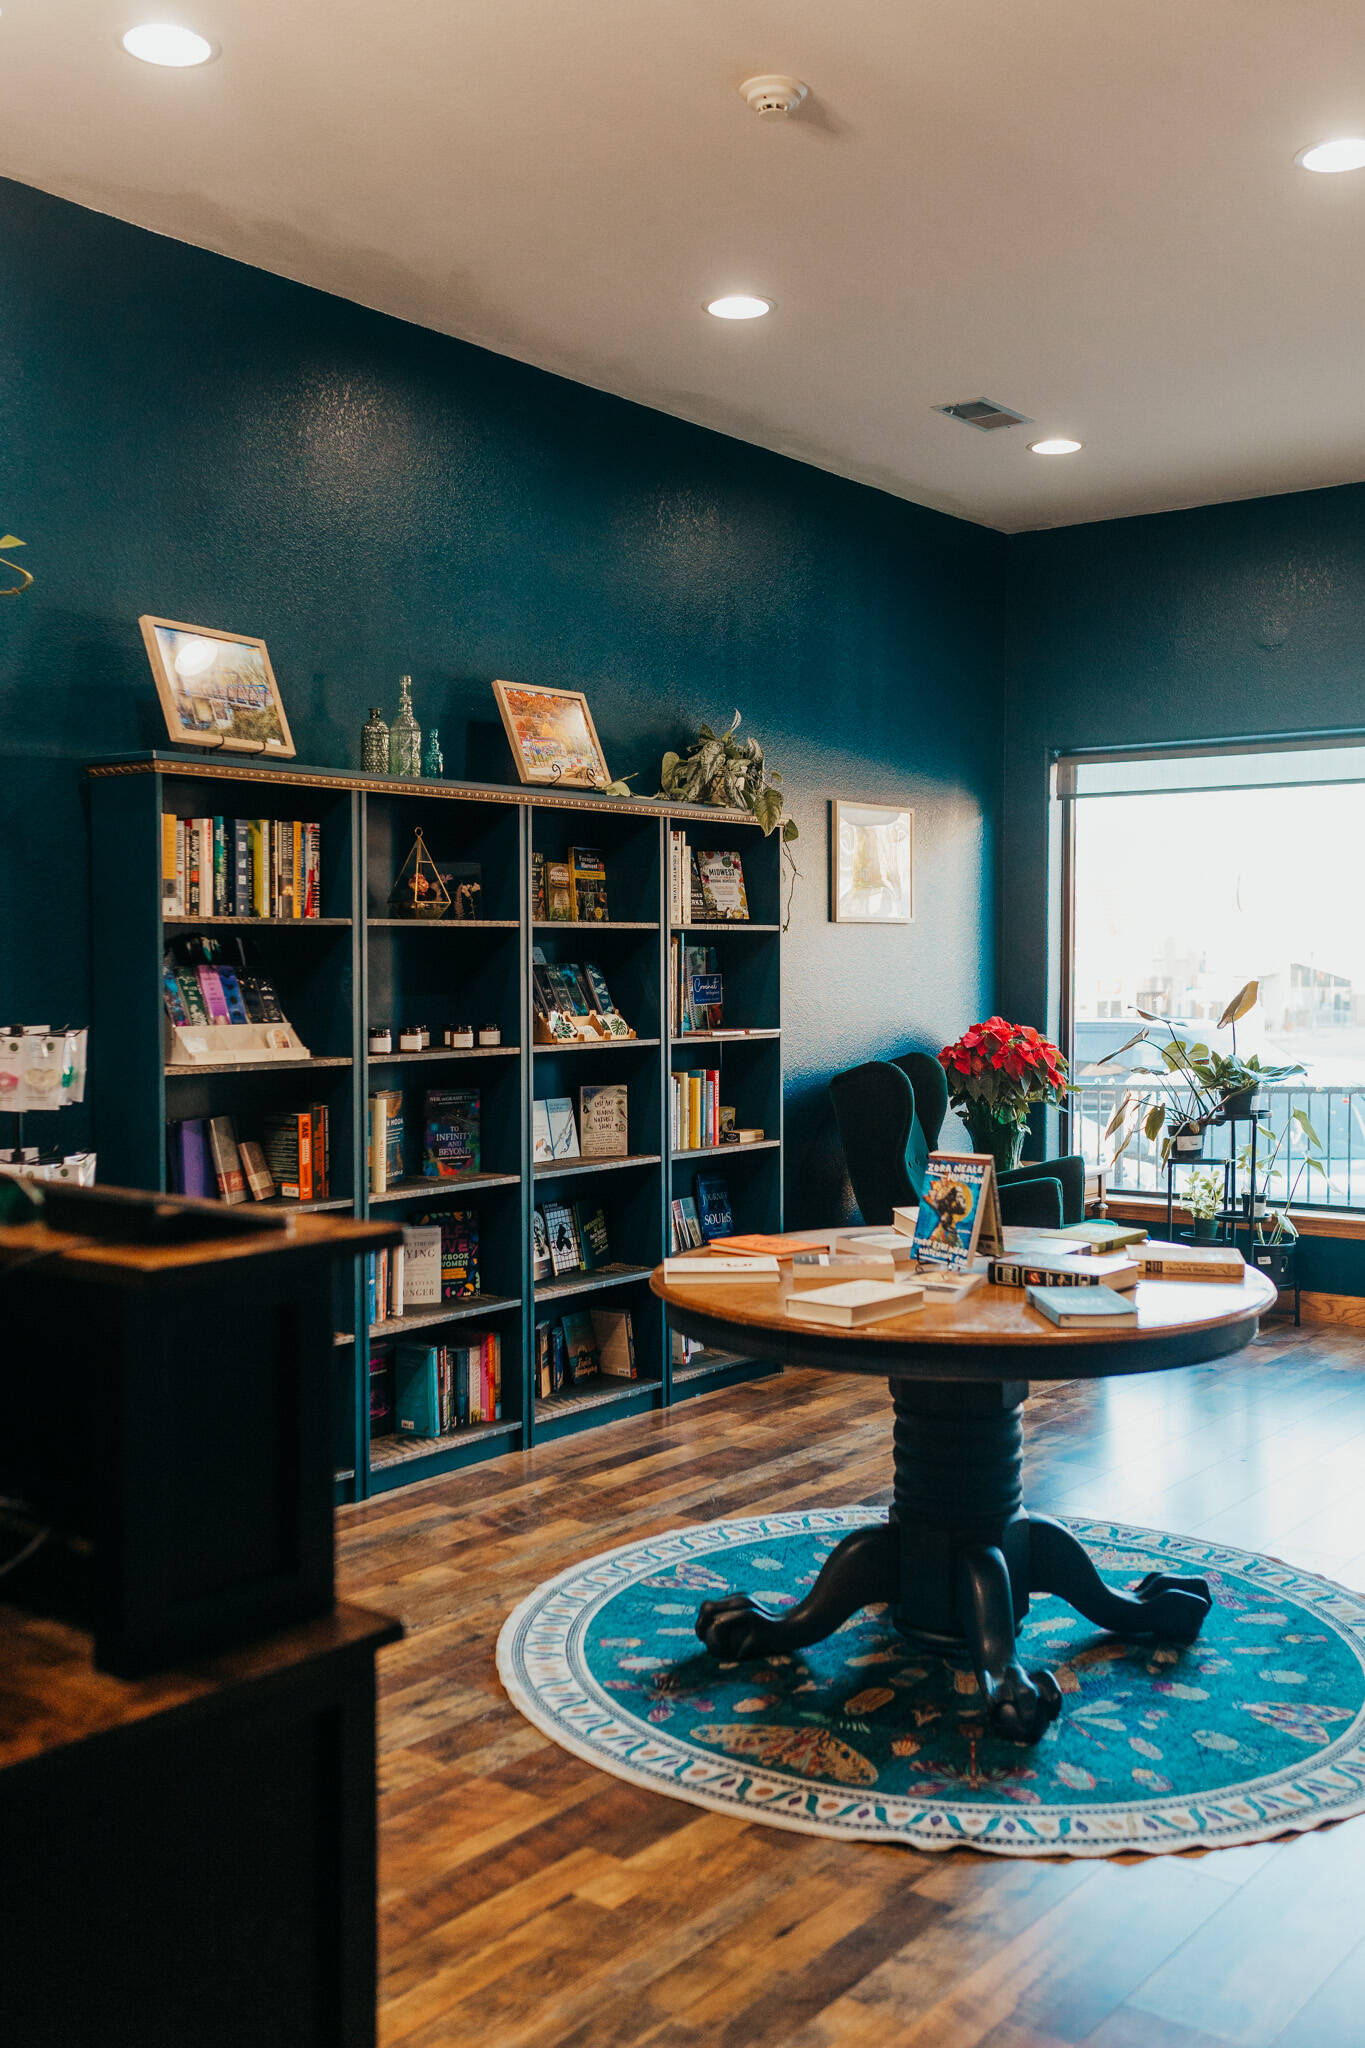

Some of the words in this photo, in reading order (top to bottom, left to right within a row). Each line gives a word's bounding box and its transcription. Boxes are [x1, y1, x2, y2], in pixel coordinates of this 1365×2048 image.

[708, 868, 735, 876] MIDWEST
[436, 1132, 473, 1142] INFINITY
[438, 1147, 472, 1156] BEYOND
[927, 1163, 952, 1173] ZORA
[953, 1164, 984, 1174] NEALE
[947, 1173, 984, 1184] HURSTON
[704, 1211, 732, 1226] SOULS
[404, 1248, 436, 1259] YING
[441, 1252, 470, 1260] KBOOK
[403, 1287, 435, 1297] UNGER
